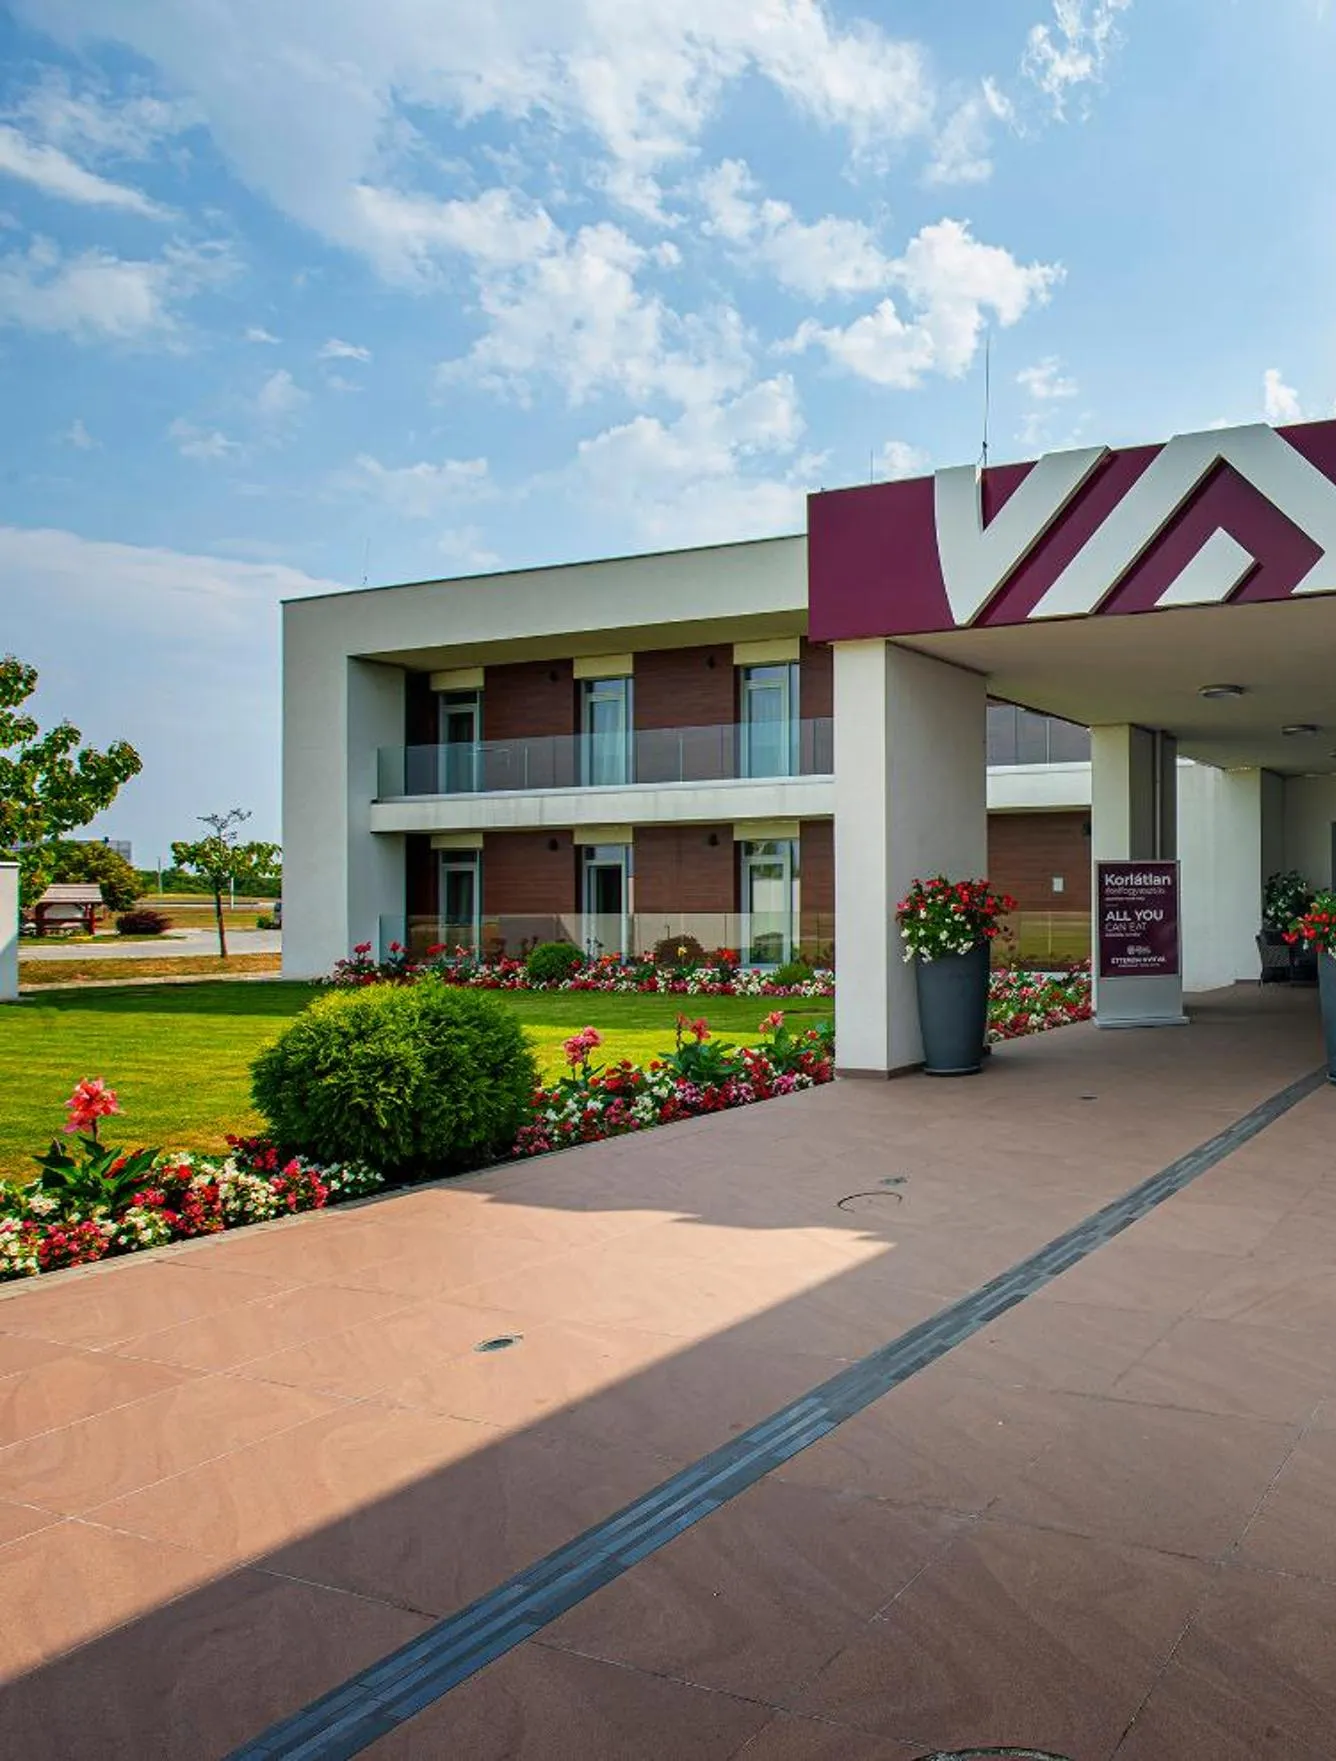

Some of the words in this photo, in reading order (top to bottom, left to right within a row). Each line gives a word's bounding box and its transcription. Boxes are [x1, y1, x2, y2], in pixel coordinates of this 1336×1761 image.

[1104, 872, 1172, 886] Korlátlan
[1105, 910, 1131, 921] ALL
[1134, 909, 1164, 921] YOU
[1105, 922, 1127, 932] CAN
[1129, 922, 1147, 932] EAT
